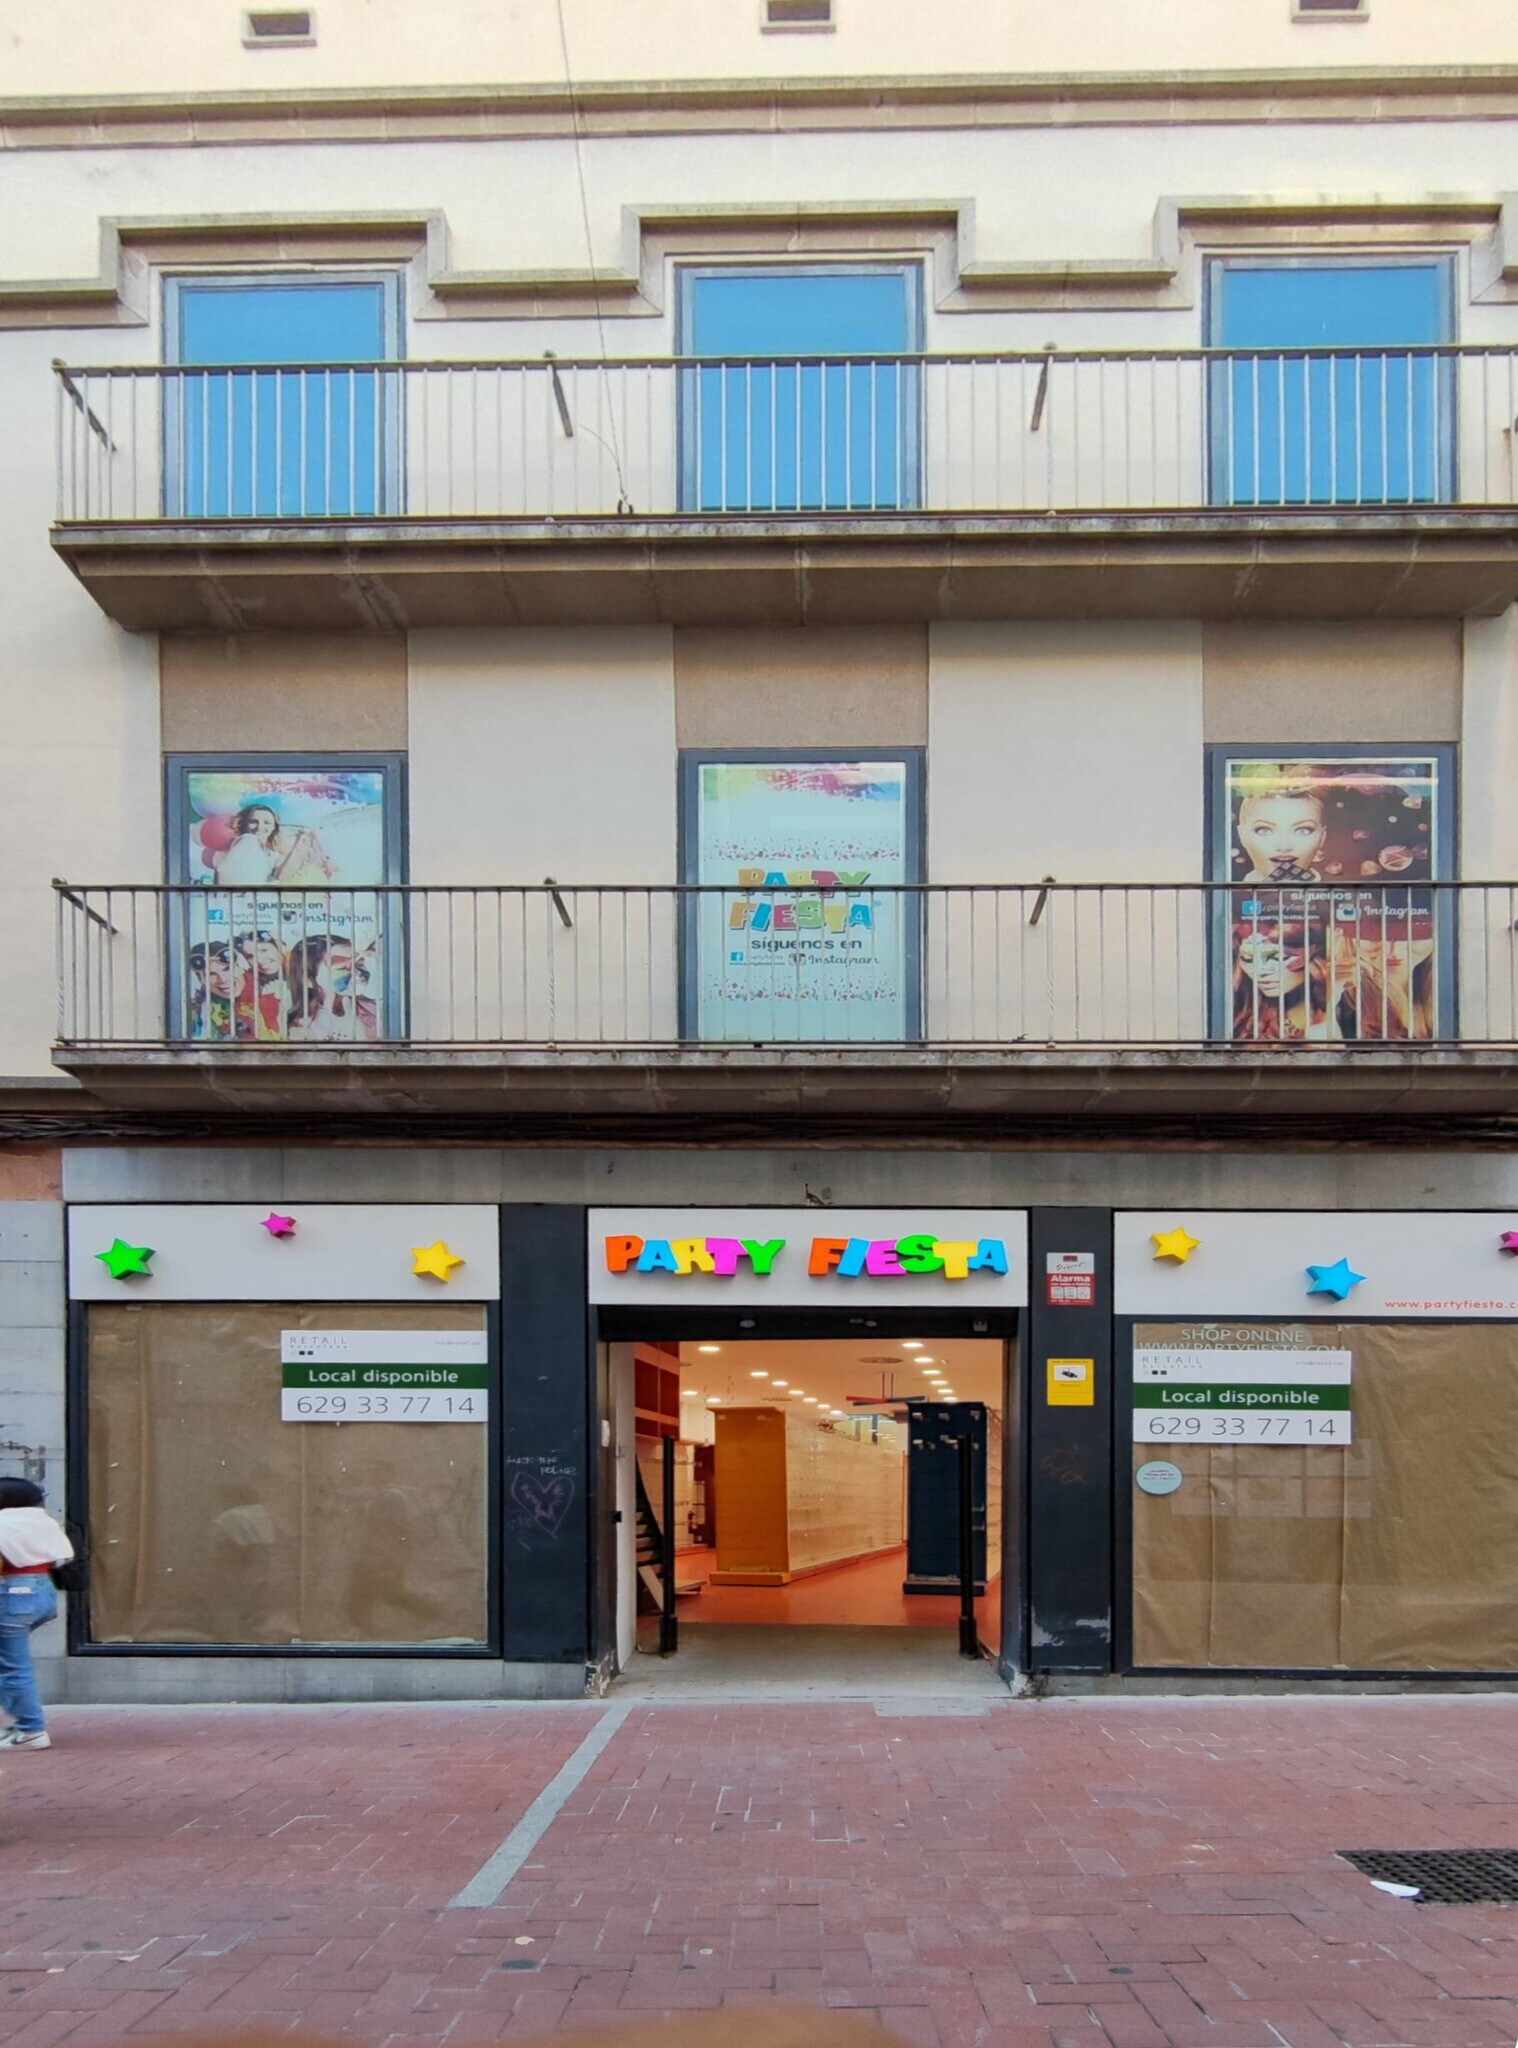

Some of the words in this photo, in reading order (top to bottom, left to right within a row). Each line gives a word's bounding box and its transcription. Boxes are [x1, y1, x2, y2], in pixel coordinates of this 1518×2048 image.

[738, 868, 871, 898] PARTY
[247, 902, 303, 911] sguenos
[729, 901, 872, 934] FIESTA
[751, 936, 834, 952] síguenos
[840, 939, 862, 950] en
[605, 1234, 787, 1276] PARTY
[808, 1233, 1009, 1280] FIESTA
[1051, 1274, 1091, 1283] Alarma
[1384, 1300, 1518, 1311] www.partyfiesta.c
[290, 1336, 348, 1344] RETAIL
[1181, 1328, 1231, 1342] SHOP
[1236, 1329, 1305, 1343] ONLINE
[1142, 1356, 1203, 1364] RETAIL
[309, 1369, 356, 1382] Local
[363, 1369, 459, 1385] disponible
[297, 1396, 347, 1414] 629
[357, 1396, 389, 1414] 33
[400, 1396, 431, 1414] 77
[444, 1397, 475, 1414] 14
[1162, 1390, 1212, 1404] Local
[1218, 1390, 1320, 1406] disponible
[1149, 1417, 1201, 1435] 629
[1211, 1417, 1245, 1436] 33
[1257, 1418, 1290, 1436] 77
[1304, 1418, 1336, 1436] 14
